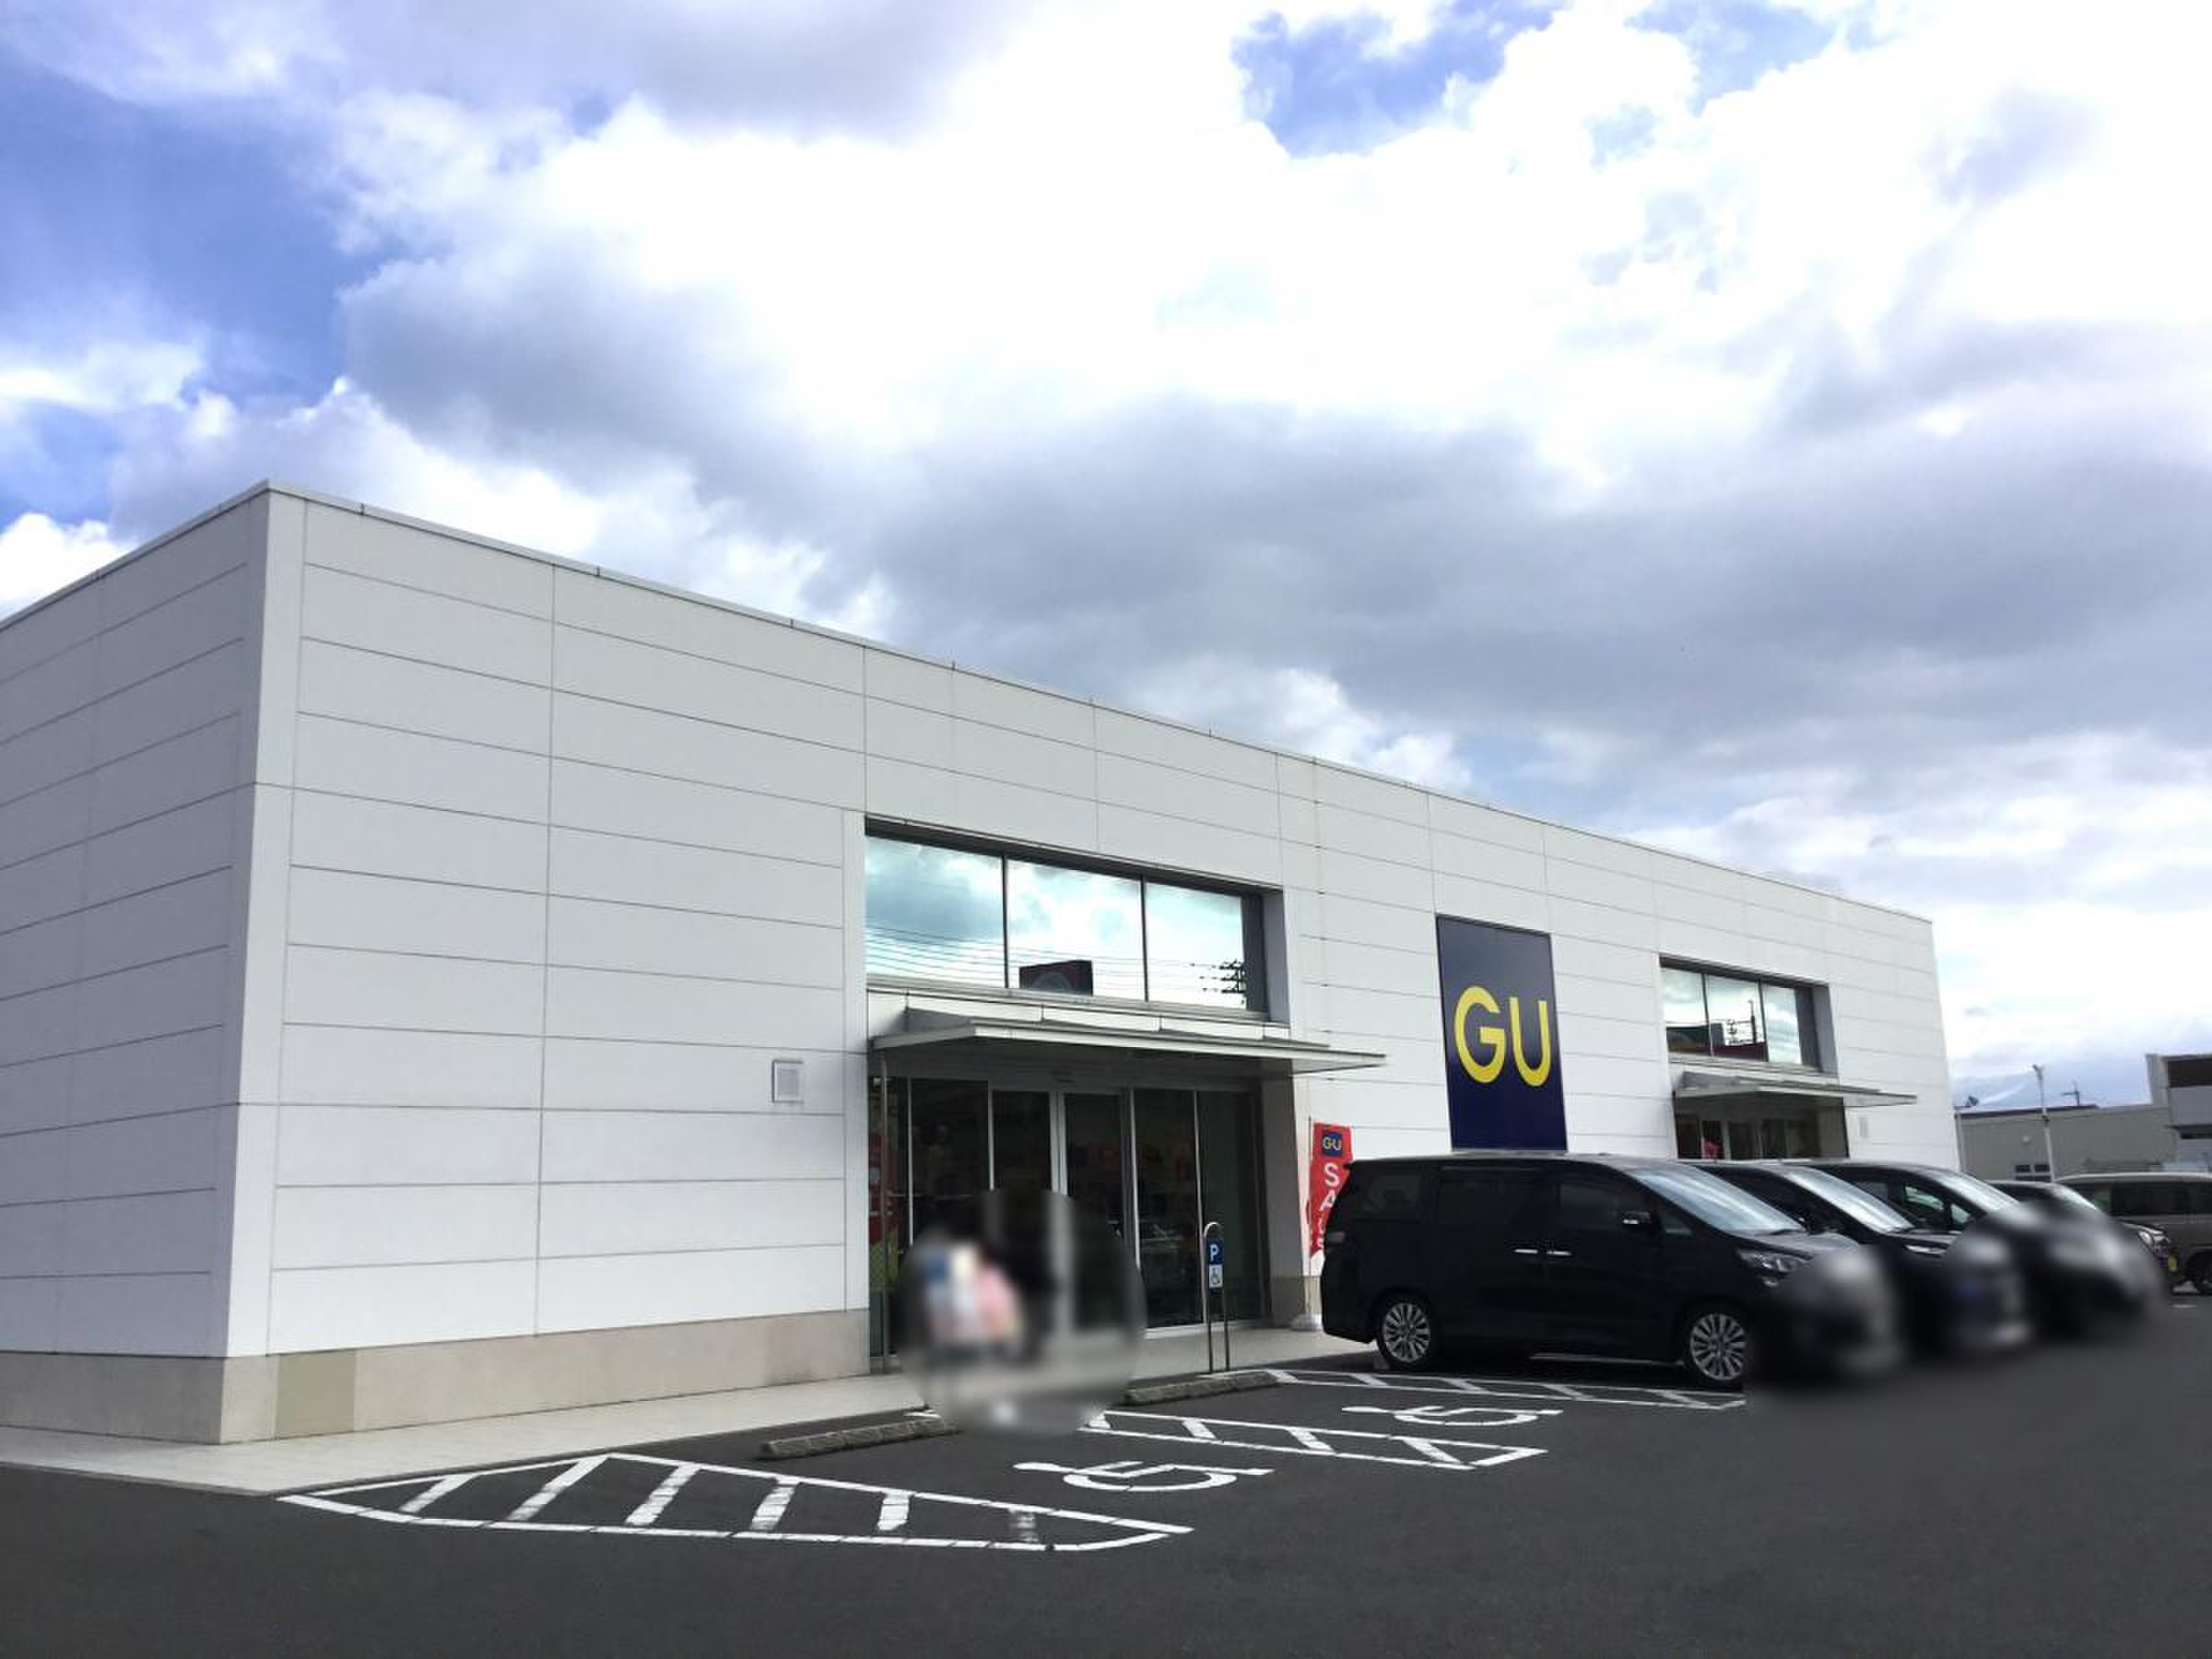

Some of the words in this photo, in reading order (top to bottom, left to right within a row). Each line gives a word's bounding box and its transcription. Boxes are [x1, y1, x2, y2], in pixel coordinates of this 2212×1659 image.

[1454, 986, 1551, 1087] GU
[1323, 1135, 1343, 1151] GU
[1209, 1243, 1219, 1263] P
